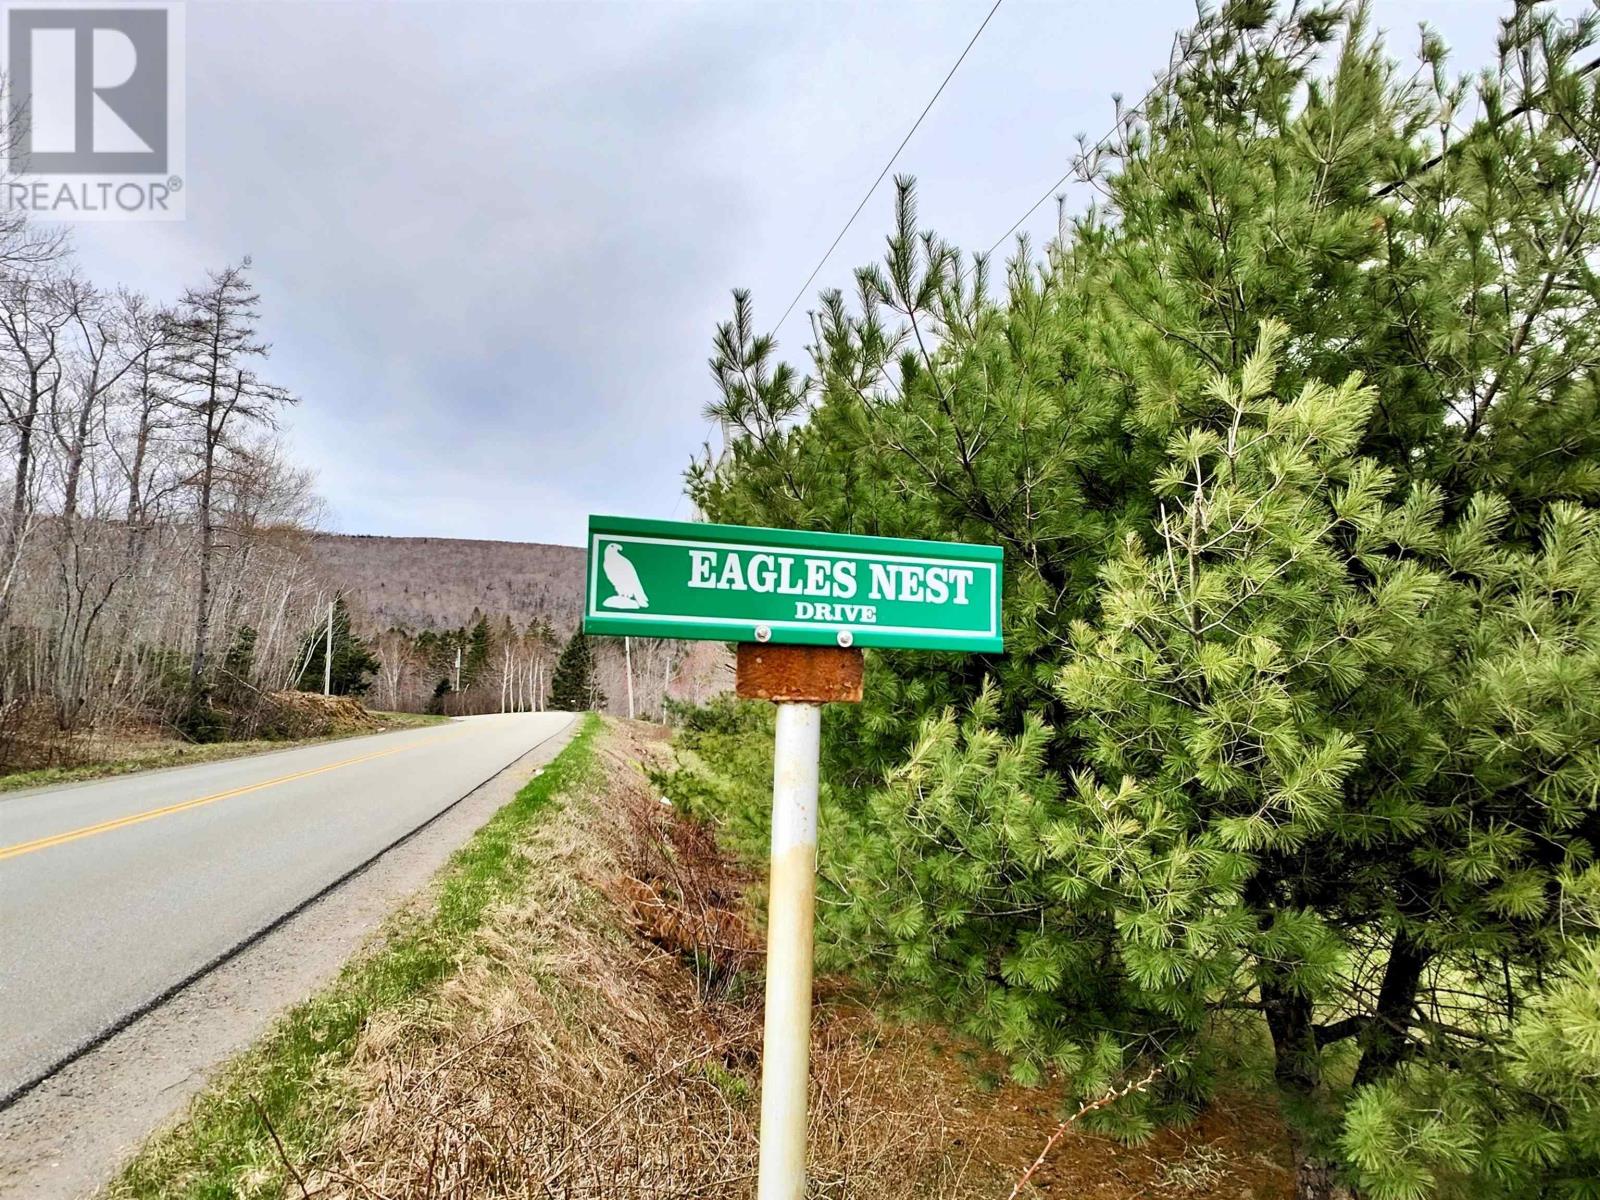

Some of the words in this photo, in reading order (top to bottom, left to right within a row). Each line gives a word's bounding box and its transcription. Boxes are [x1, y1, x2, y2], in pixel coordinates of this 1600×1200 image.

[687, 549, 857, 598] EAGLES
[868, 563, 973, 605] NEST
[794, 601, 877, 623] DRIVE
